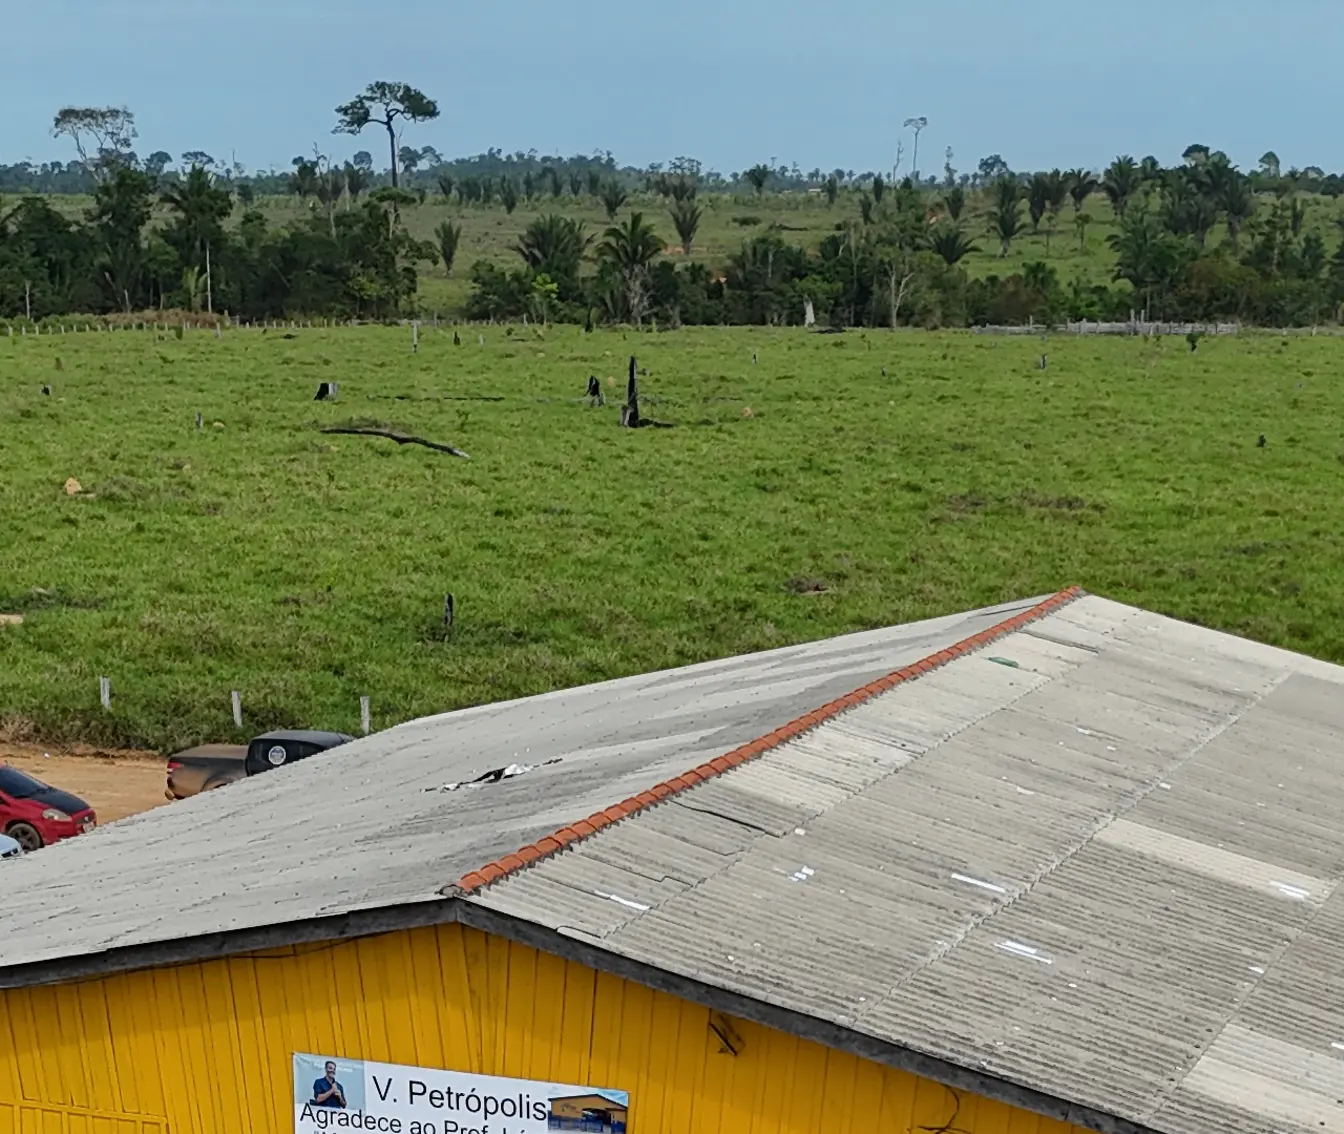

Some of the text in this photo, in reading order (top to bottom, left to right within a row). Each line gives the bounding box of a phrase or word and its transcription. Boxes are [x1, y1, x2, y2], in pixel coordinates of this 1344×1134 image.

[372, 1075, 547, 1121] V. Petrópolis
[300, 1102, 402, 1134] Agradece
